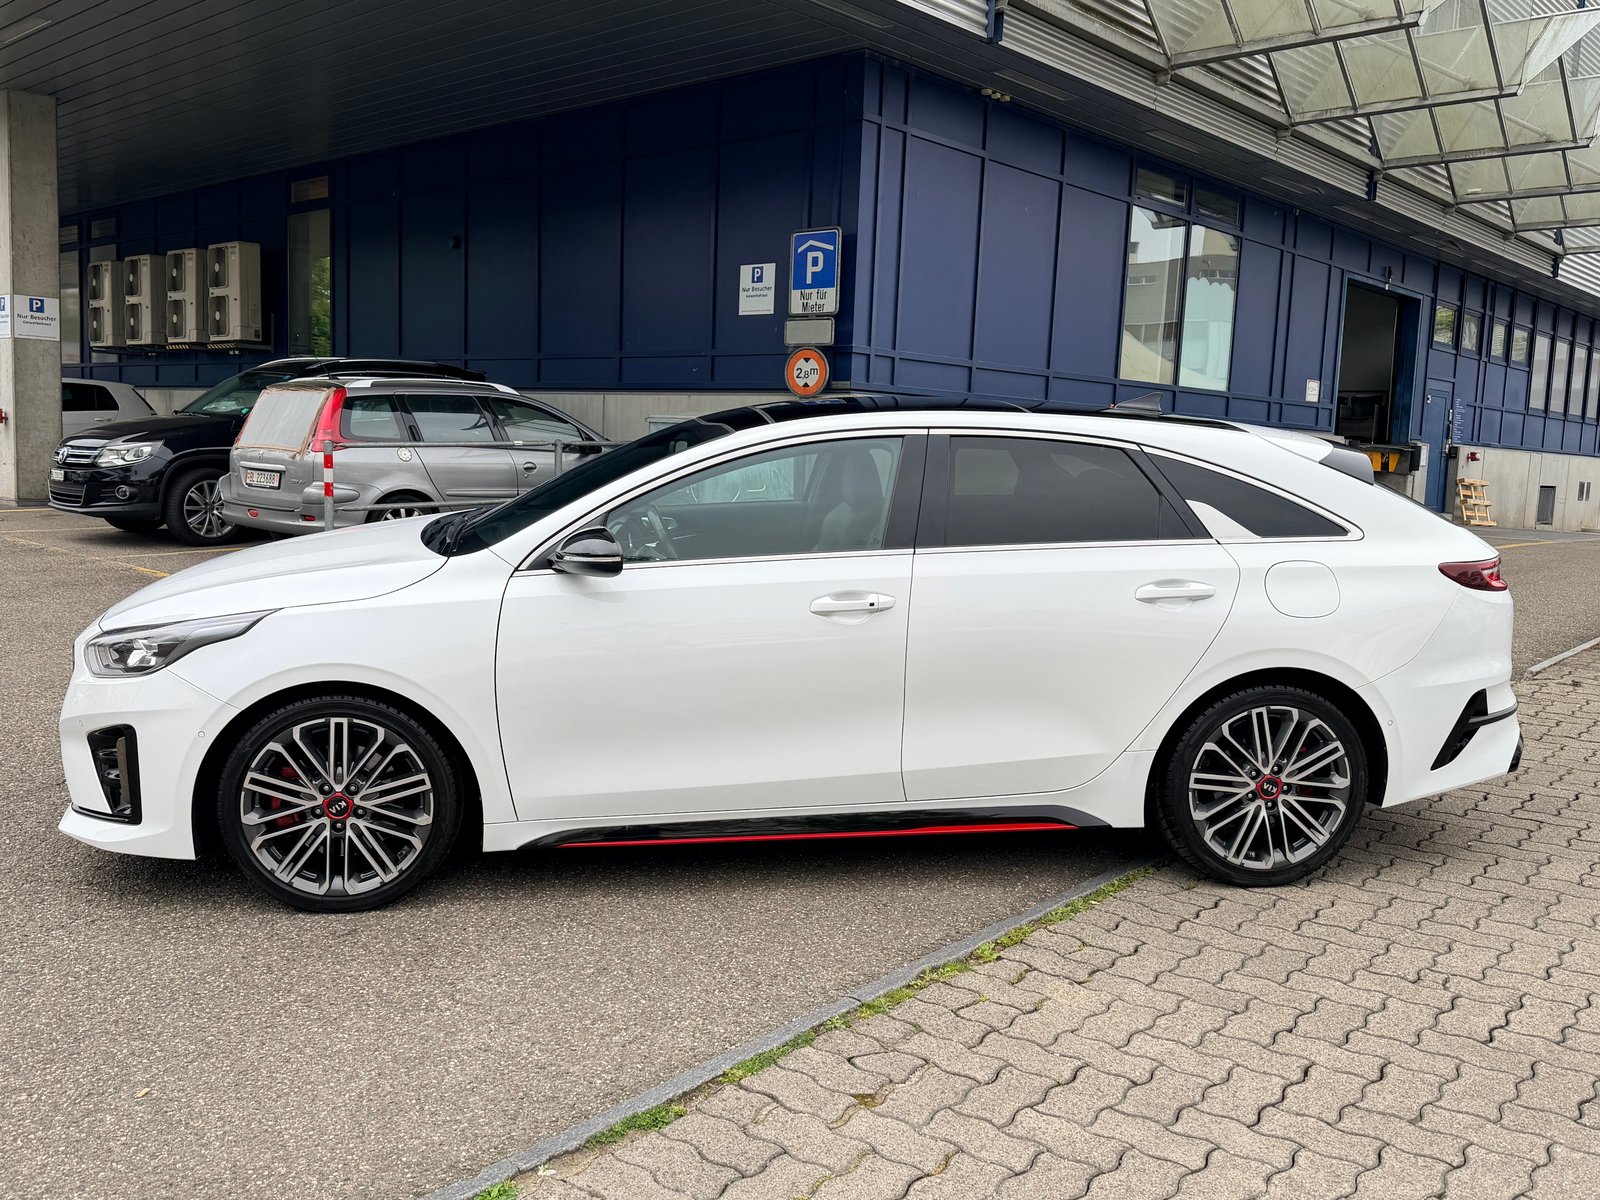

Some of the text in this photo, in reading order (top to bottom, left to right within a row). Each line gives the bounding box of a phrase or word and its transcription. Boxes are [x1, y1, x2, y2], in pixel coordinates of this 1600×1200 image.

[806, 251, 824, 285] P
[754, 268, 761, 282] P
[800, 289, 827, 300] Nur für
[32, 299, 42, 312] P
[801, 302, 825, 312] Mieter
[30, 314, 57, 322] Besucher
[1263, 782, 1278, 794] KIA
[328, 800, 347, 814] KIA
